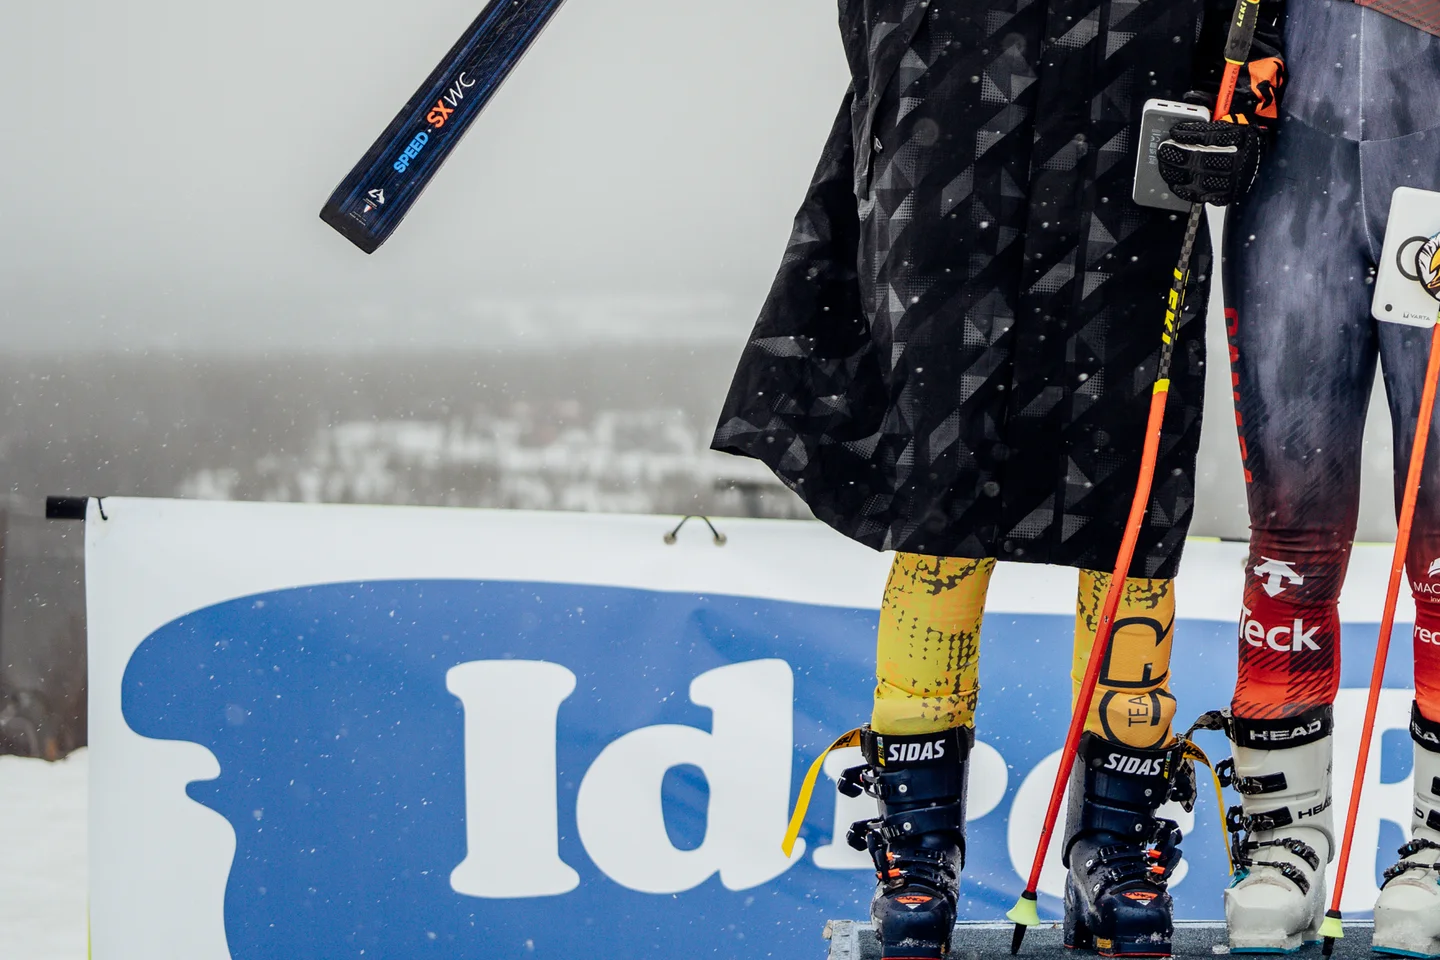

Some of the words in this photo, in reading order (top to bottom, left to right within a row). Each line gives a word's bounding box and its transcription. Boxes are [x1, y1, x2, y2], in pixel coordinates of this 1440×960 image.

[1236, 1, 1247, 27] LEKI
[393, 131, 429, 173] SPEED
[1410, 313, 1431, 321] VARTA
[1239, 604, 1321, 652] Teck
[1127, 694, 1149, 728] TEA
[1250, 719, 1322, 741] HEAD
[887, 739, 946, 762] SIDAS
[1103, 753, 1164, 776] SIDAS
[1298, 799, 1333, 820] HEA
